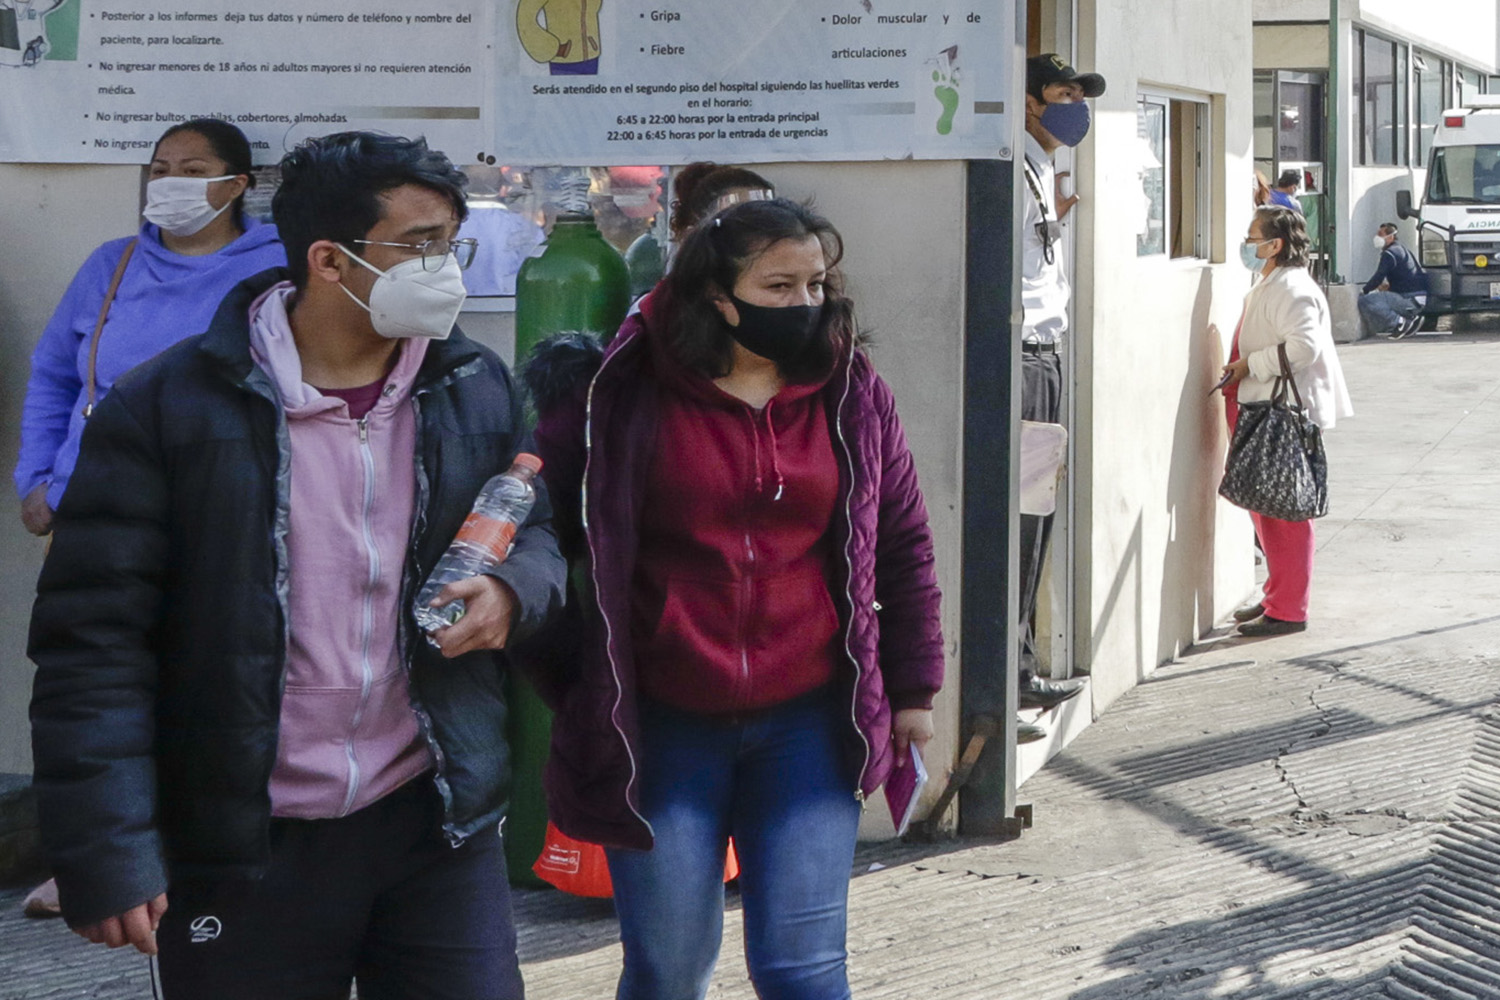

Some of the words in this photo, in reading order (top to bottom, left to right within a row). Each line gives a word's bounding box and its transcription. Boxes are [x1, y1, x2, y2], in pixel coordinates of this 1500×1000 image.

[100, 10, 146, 21] Posterior
[156, 10, 172, 22] los
[174, 10, 218, 22] informes
[223, 11, 246, 24] deja
[248, 12, 264, 22] tus
[266, 11, 294, 22] datos
[305, 12, 345, 23] número
[361, 12, 403, 23] teléfono
[413, 12, 453, 24] nombre
[454, 12, 472, 24] del
[649, 9, 681, 24] Gripa
[831, 13, 862, 26] Dolor
[876, 11, 928, 24] muscular
[965, 11, 981, 23] de
[99, 34, 145, 46] paciente,
[146, 36, 170, 47] para
[171, 34, 224, 45] localizarte.
[650, 43, 685, 56] Fiebre
[830, 45, 907, 59] articulaciones
[98, 60, 114, 71] No
[115, 61, 157, 74] ingresar
[157, 63, 201, 72] menores
[218, 61, 231, 72] 18
[232, 61, 258, 72] años
[271, 61, 309, 73] adultos
[309, 64, 352, 75] mayores
[379, 62, 426, 75] requieren
[427, 62, 472, 74] atención
[532, 83, 561, 95] Serás
[562, 82, 608, 95] atendido
[608, 85, 622, 94] en
[623, 82, 634, 94] el
[635, 81, 677, 96] segundo
[678, 81, 700, 95] piso
[701, 81, 718, 93] del
[718, 80, 759, 94] hospital
[759, 79, 808, 94] siguiendo
[808, 79, 823, 90] las
[824, 78, 866, 90] huellitas
[866, 78, 900, 89] verdes
[686, 99, 700, 109] en
[701, 96, 712, 108] el
[712, 96, 752, 108] horario:
[96, 112, 111, 121] No
[113, 112, 154, 123] ingresar
[237, 112, 292, 123] cobertores,
[615, 114, 638, 125] 6:45
[648, 113, 676, 125] 22:00
[677, 112, 705, 124] horas
[706, 114, 725, 125] por
[725, 112, 736, 123] la
[736, 111, 776, 123] entrada
[777, 110, 820, 124] principal
[606, 129, 635, 141] 22:00
[644, 129, 667, 141] 6:45
[668, 128, 696, 140] horas
[697, 130, 716, 141] por
[716, 128, 727, 139] la
[728, 127, 767, 139] entrada
[767, 127, 781, 138] de
[782, 125, 829, 140] urgencias
[94, 139, 109, 148] No
[111, 139, 152, 150] ingresar
